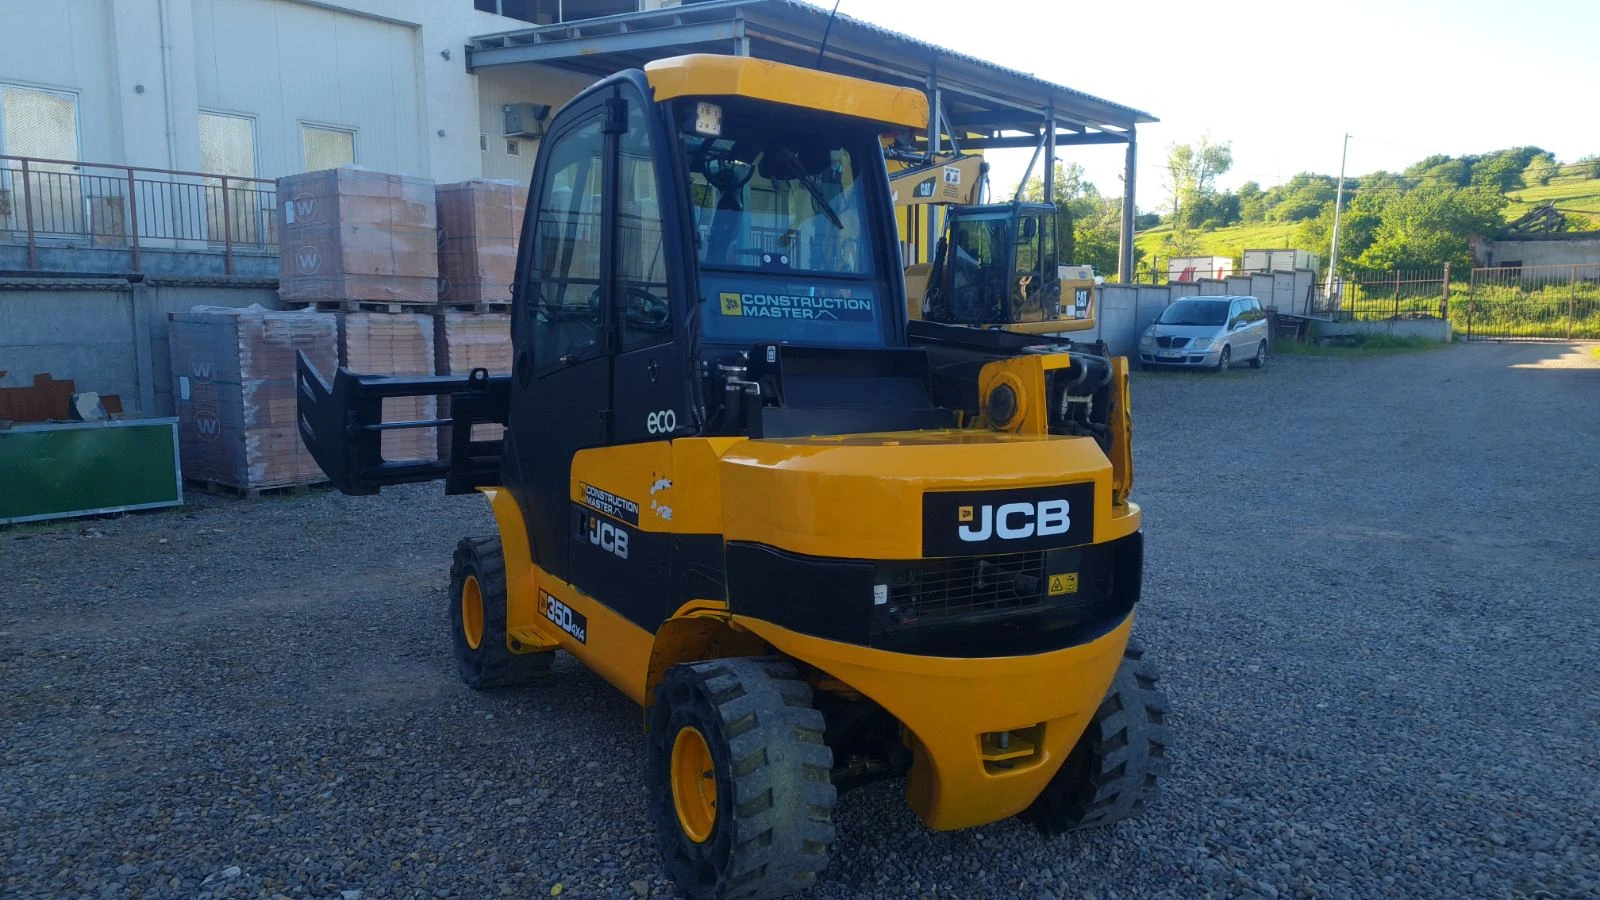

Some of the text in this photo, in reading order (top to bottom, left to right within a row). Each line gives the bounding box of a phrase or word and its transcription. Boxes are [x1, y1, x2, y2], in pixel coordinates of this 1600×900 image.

[921, 182, 930, 195] CAT
[296, 201, 313, 215] W
[299, 254, 317, 269] W
[742, 294, 870, 311] CONSTRUCTION
[1076, 291, 1088, 307] CAT
[743, 306, 813, 319] MASTER
[193, 364, 210, 377] W
[198, 420, 217, 434] W
[648, 410, 676, 434] eco
[586, 486, 638, 514] CONSTRUCTION
[586, 495, 613, 515] MASTER
[959, 499, 1070, 542] JCB
[590, 520, 628, 560] JCB
